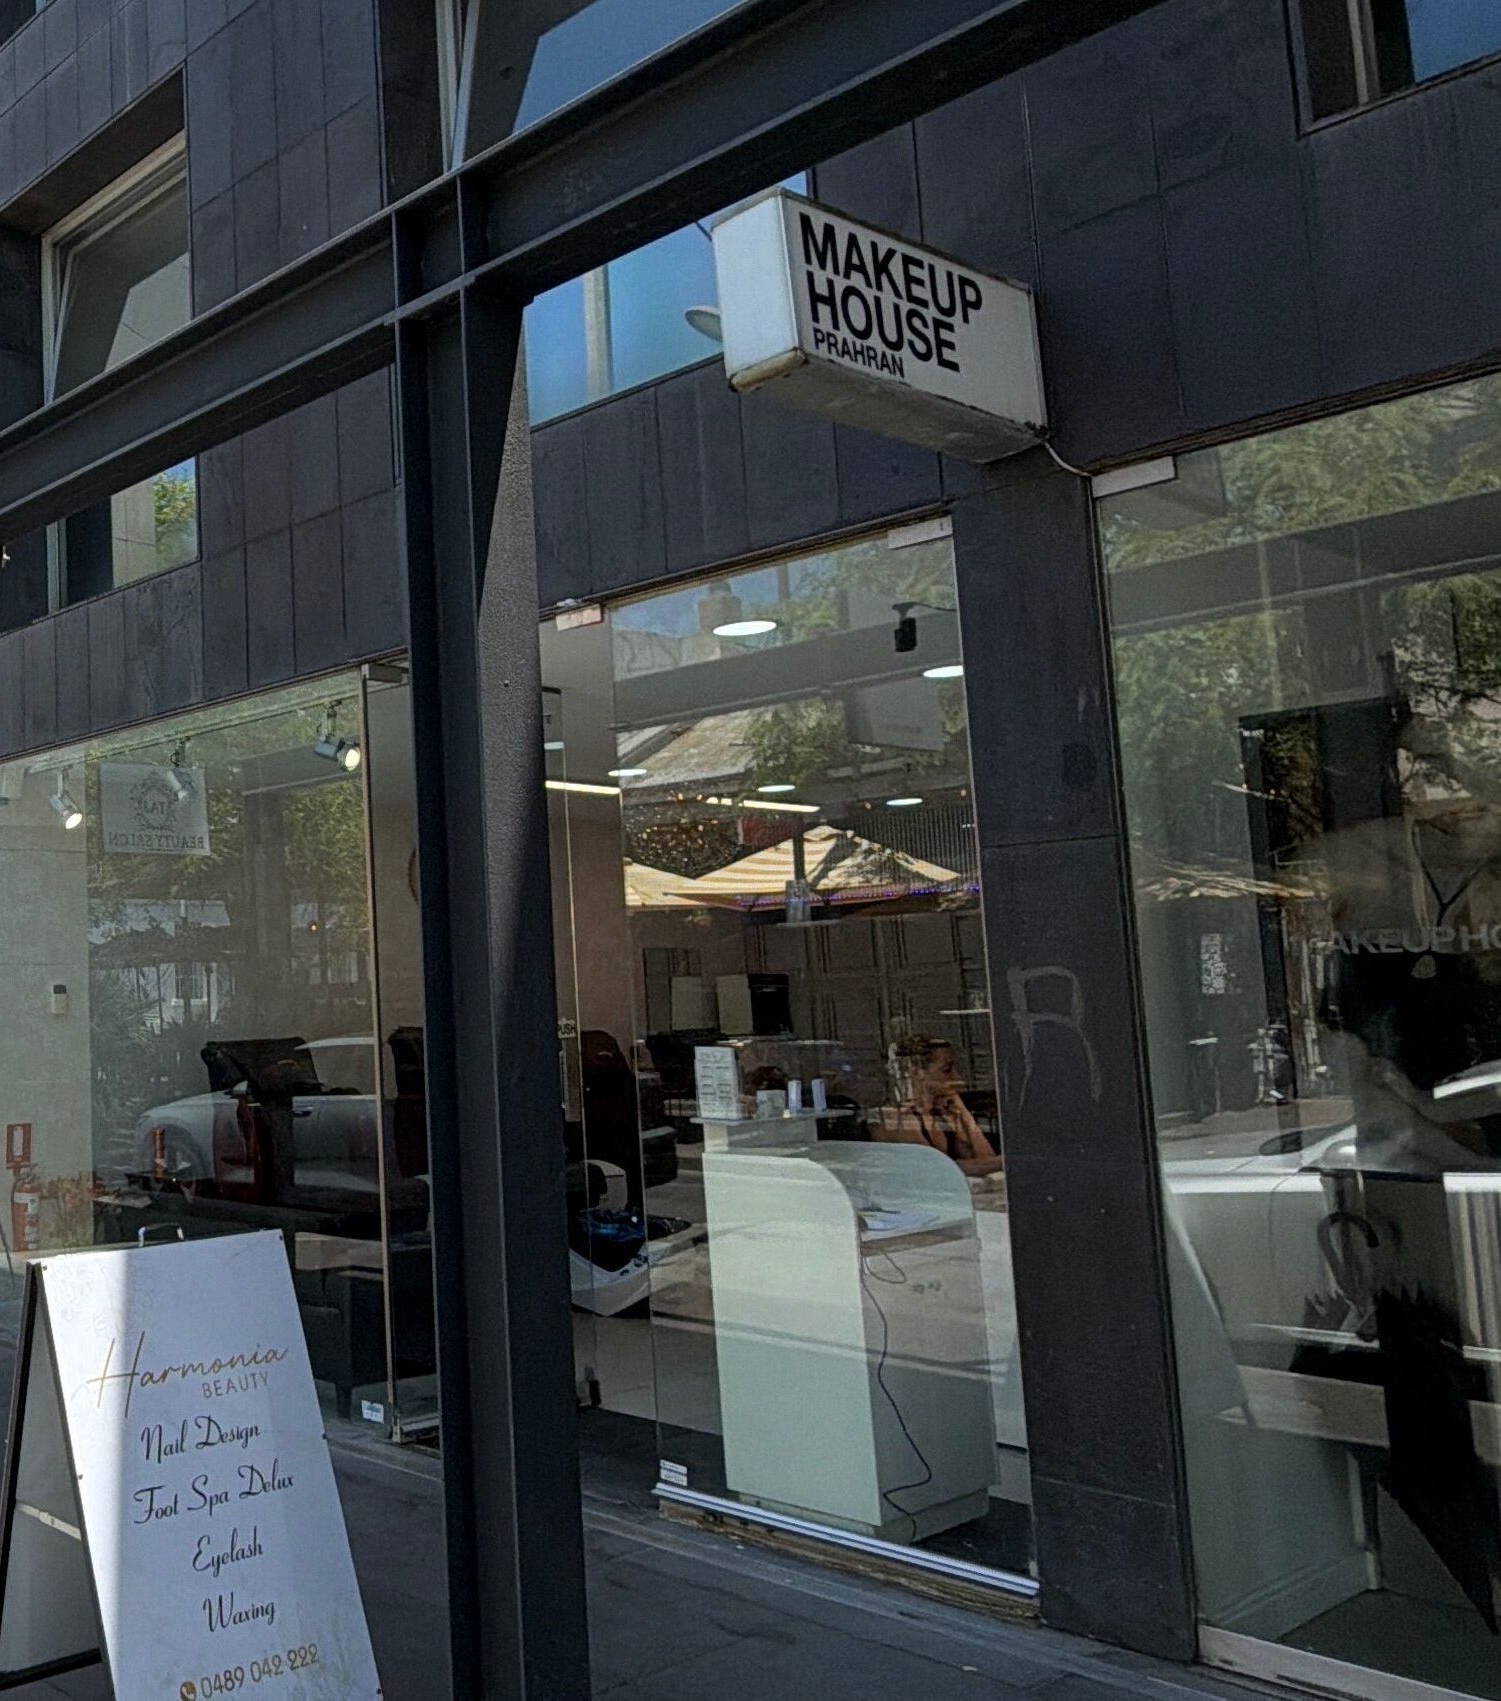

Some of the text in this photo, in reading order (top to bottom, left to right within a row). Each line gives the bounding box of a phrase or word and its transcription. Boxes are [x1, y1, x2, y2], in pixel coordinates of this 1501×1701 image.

[799, 211, 983, 325] MAKEUP
[806, 270, 960, 373] HOUSE
[813, 327, 905, 379] PRAHRAN
[86, 1330, 289, 1418] Harmonia
[202, 1371, 271, 1399] BEAUTY
[140, 1415, 260, 1464] Nail Design
[133, 1484, 179, 1524] Foot
[187, 1474, 230, 1517] Spa
[192, 1525, 264, 1578] Eyelash
[203, 1591, 275, 1633] Waxing
[201, 1643, 320, 1698] 0489 042 222
